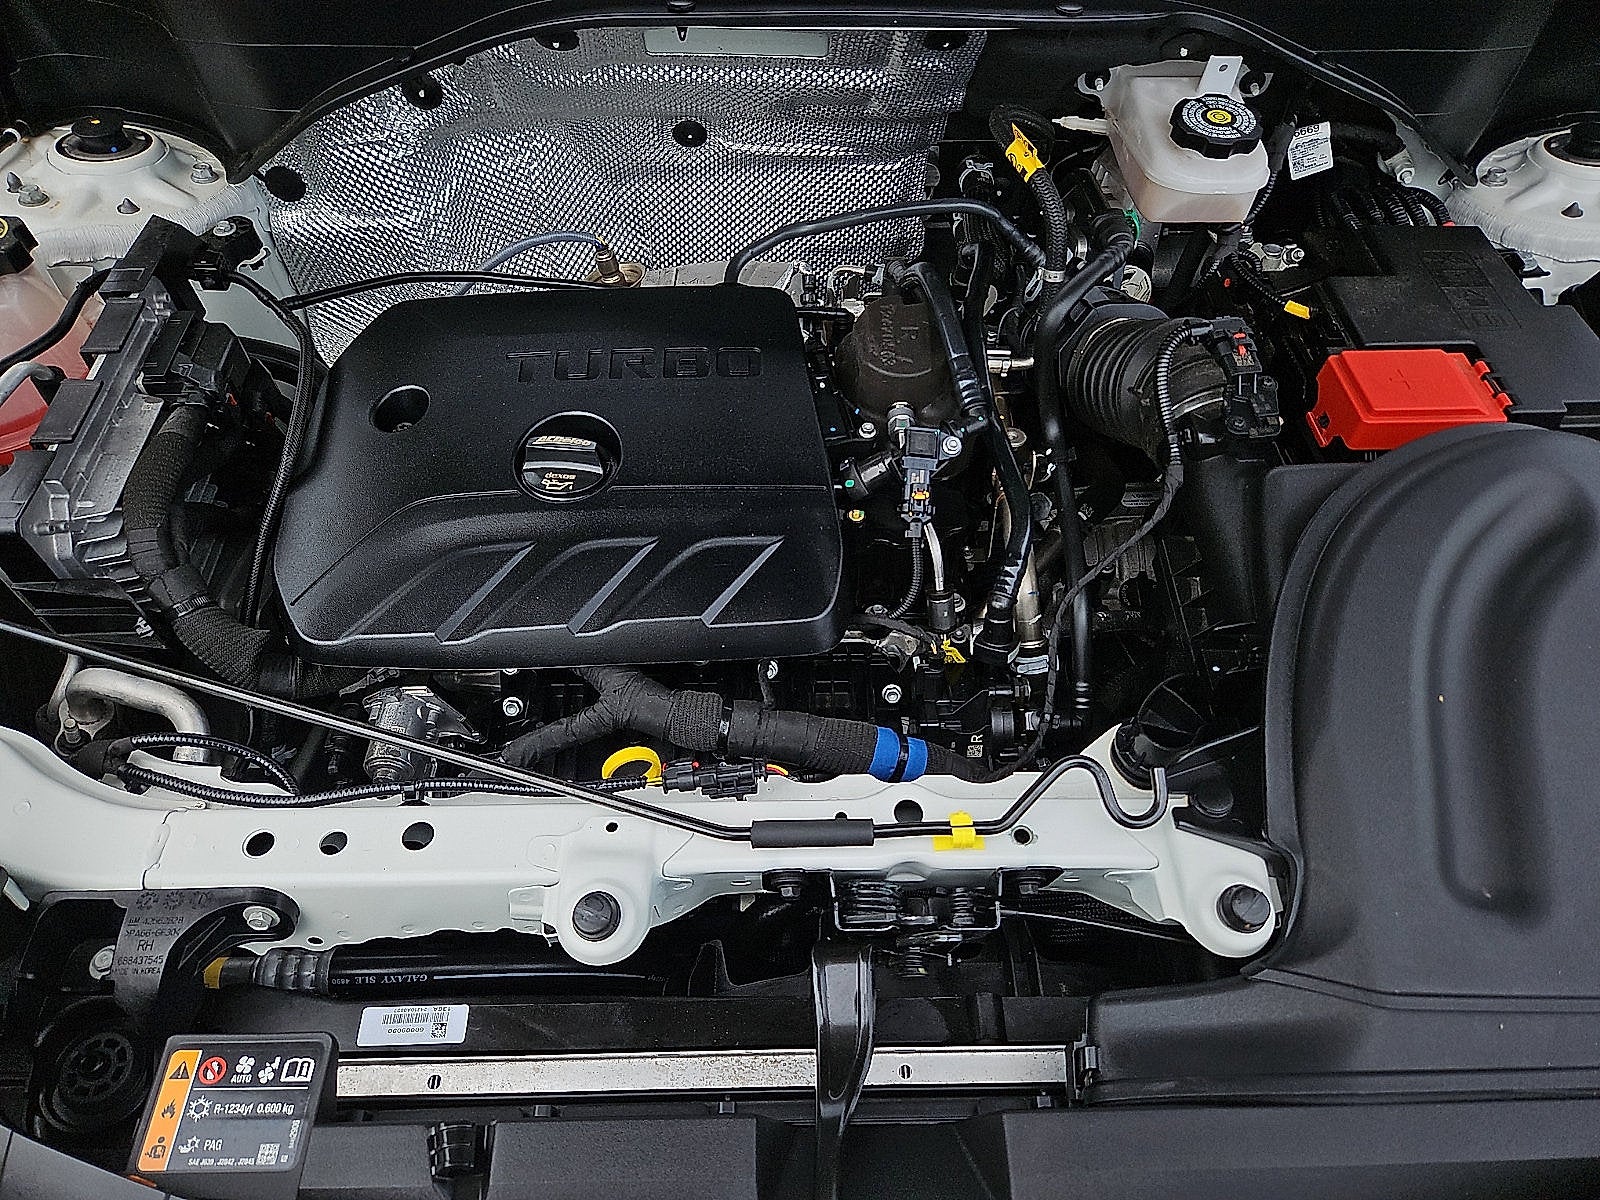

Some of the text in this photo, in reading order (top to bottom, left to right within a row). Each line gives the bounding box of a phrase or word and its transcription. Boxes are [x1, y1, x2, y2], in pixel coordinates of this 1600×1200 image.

[506, 346, 763, 384] TURBO
[545, 471, 577, 480] dexos
[136, 939, 155, 952] RH
[354, 975, 377, 985] SLE
[380, 973, 429, 983] GALAXY
[230, 1073, 252, 1084] AUTO
[213, 1102, 295, 1116] R-1234yf 0.600 kg
[203, 1139, 223, 1151] PAG
